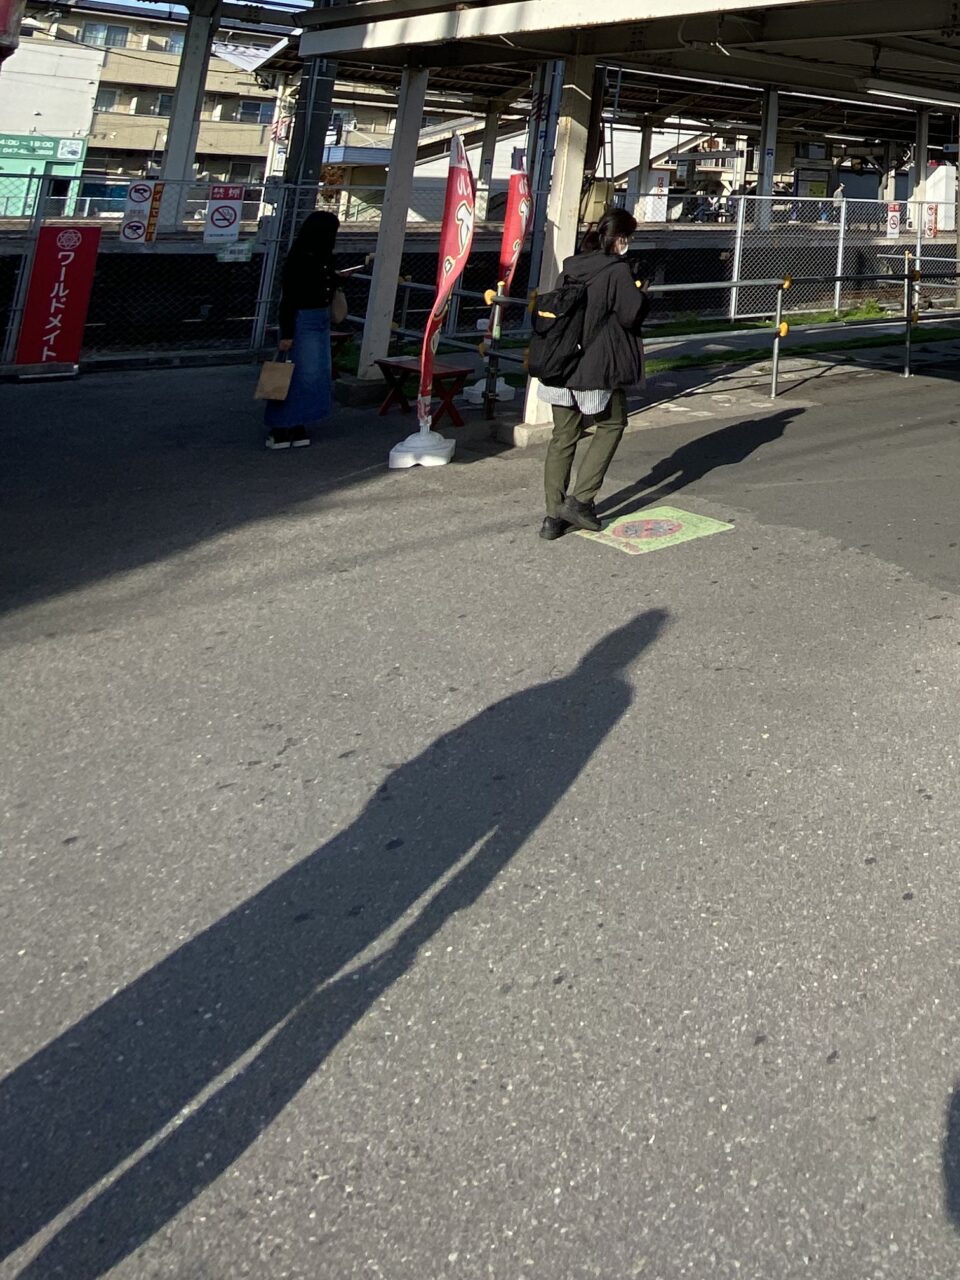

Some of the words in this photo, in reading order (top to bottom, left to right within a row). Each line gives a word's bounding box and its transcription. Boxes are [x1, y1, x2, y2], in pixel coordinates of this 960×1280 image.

[42, 251, 75, 361] ワールドメイト
